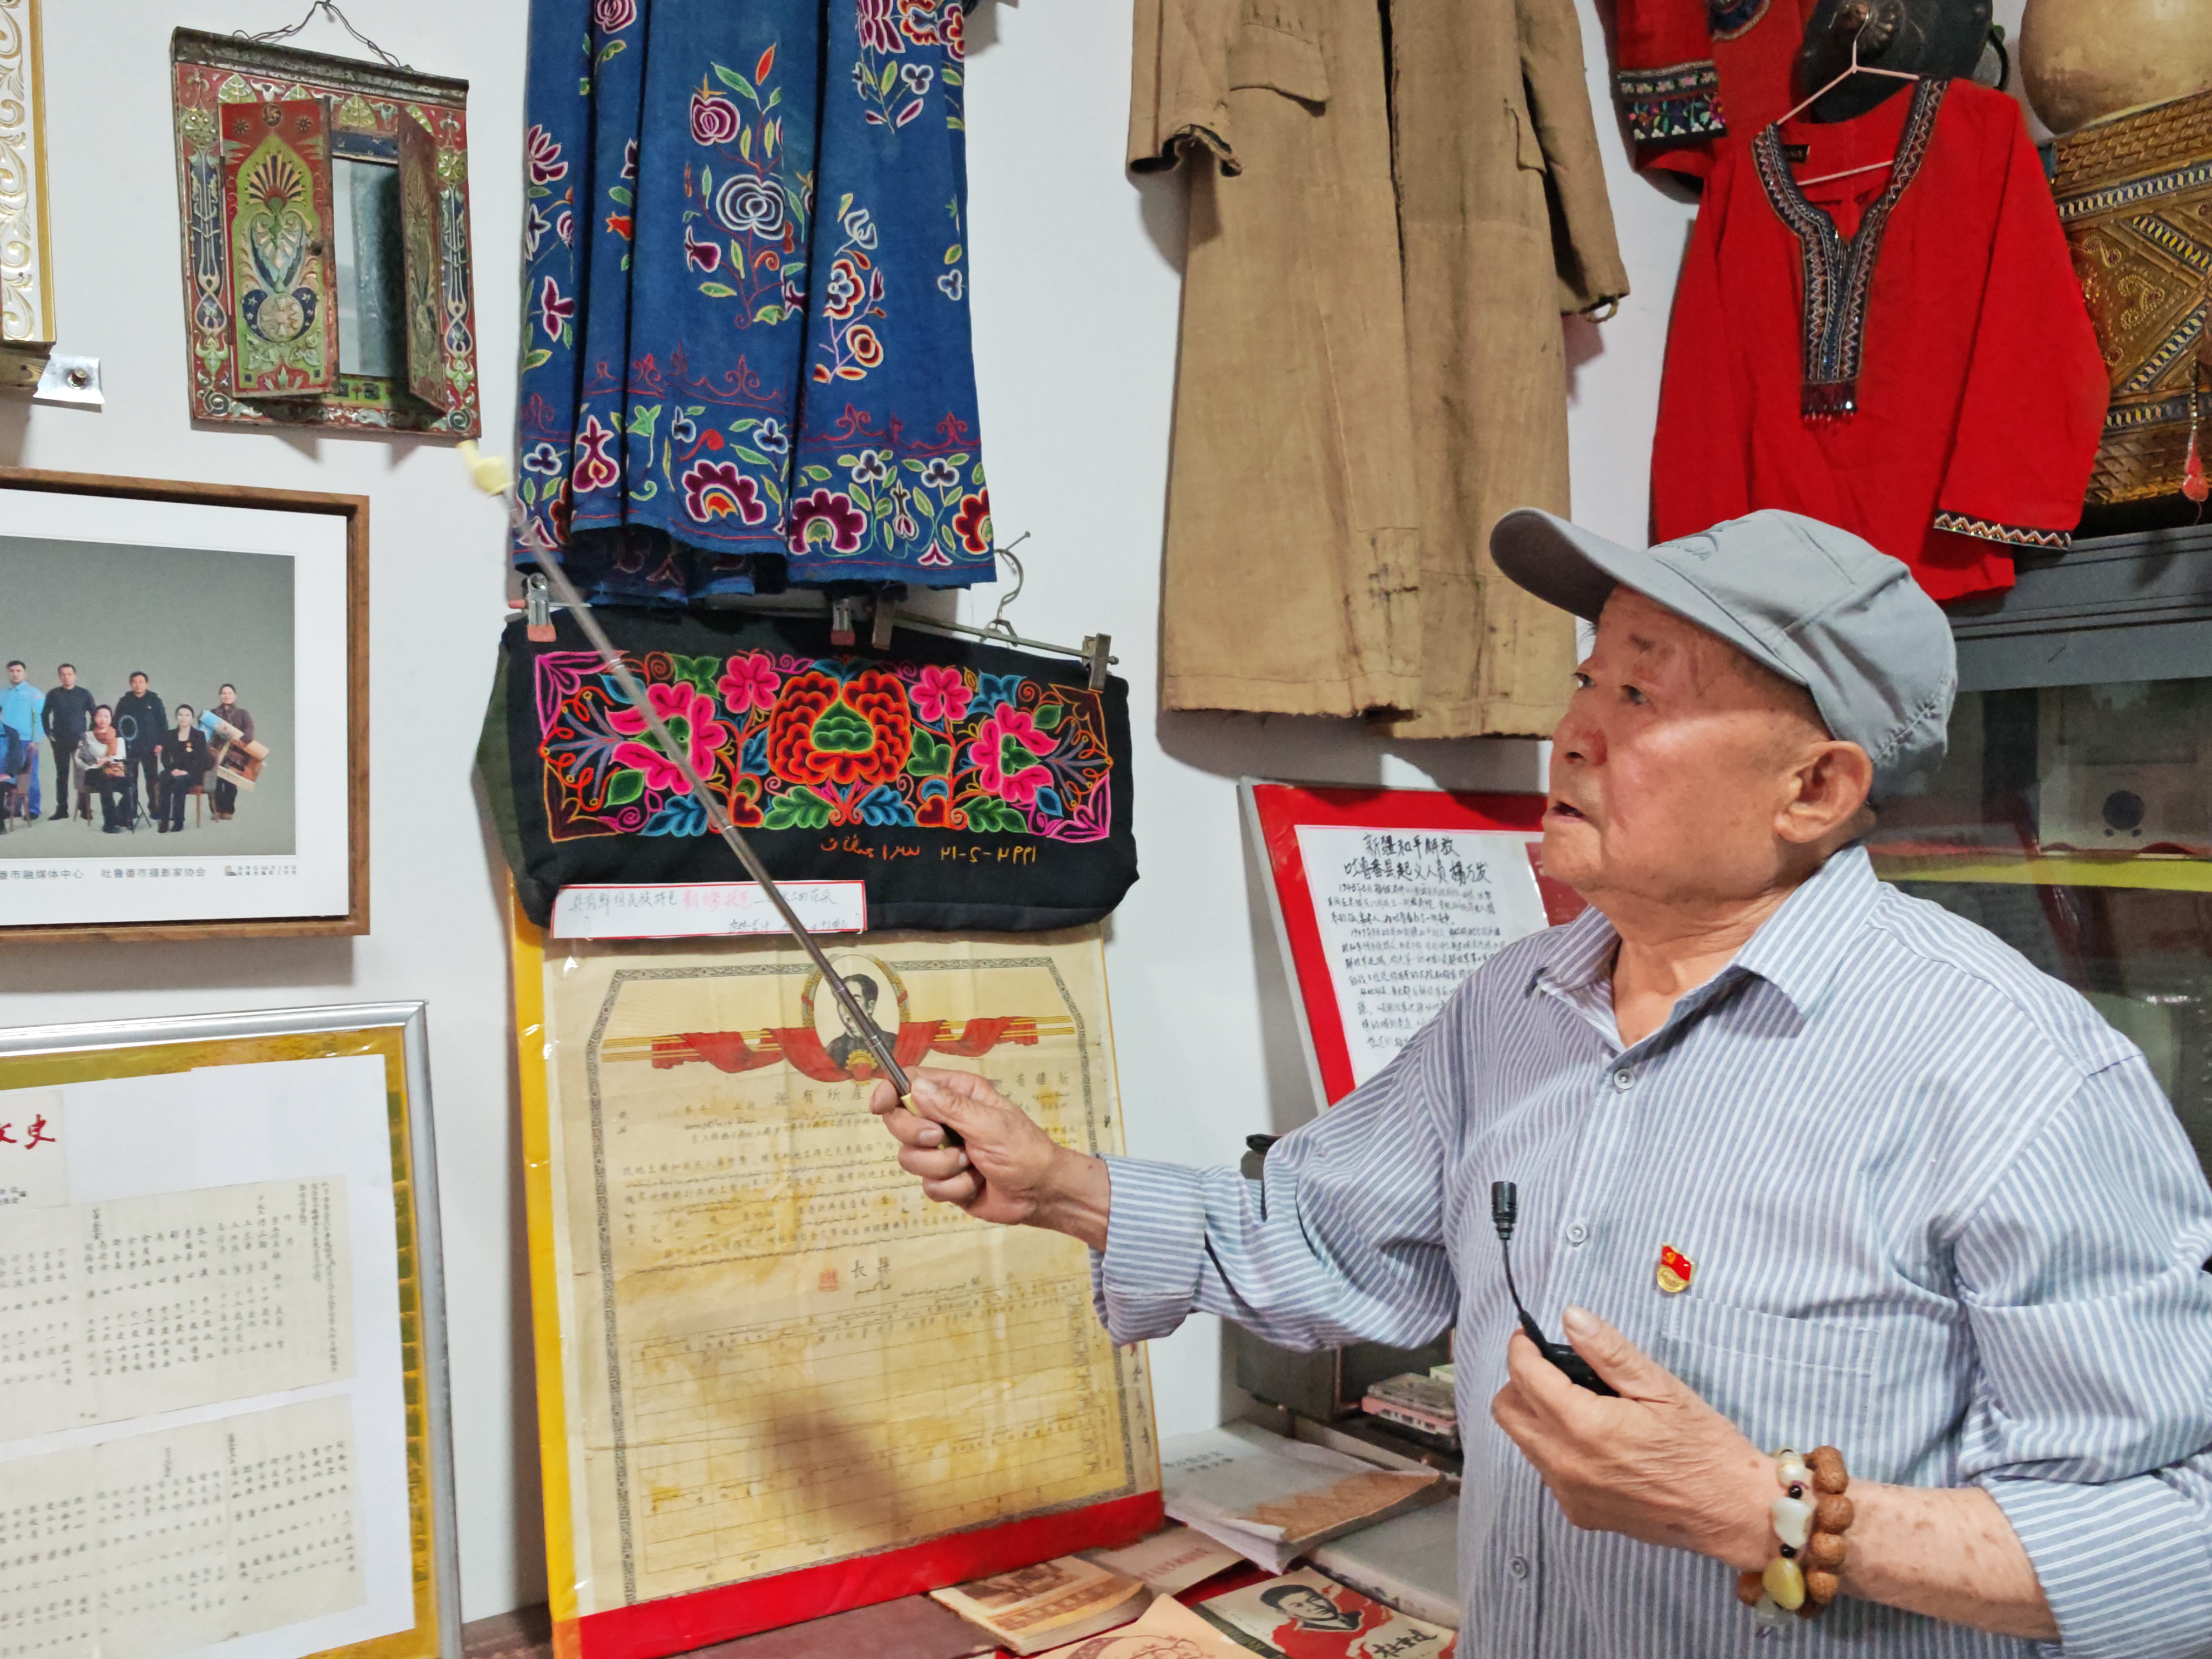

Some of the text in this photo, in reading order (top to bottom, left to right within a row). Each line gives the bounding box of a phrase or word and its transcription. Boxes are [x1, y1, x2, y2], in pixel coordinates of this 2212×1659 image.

[101, 867, 207, 879] 吐鲁番市摄影家协会
